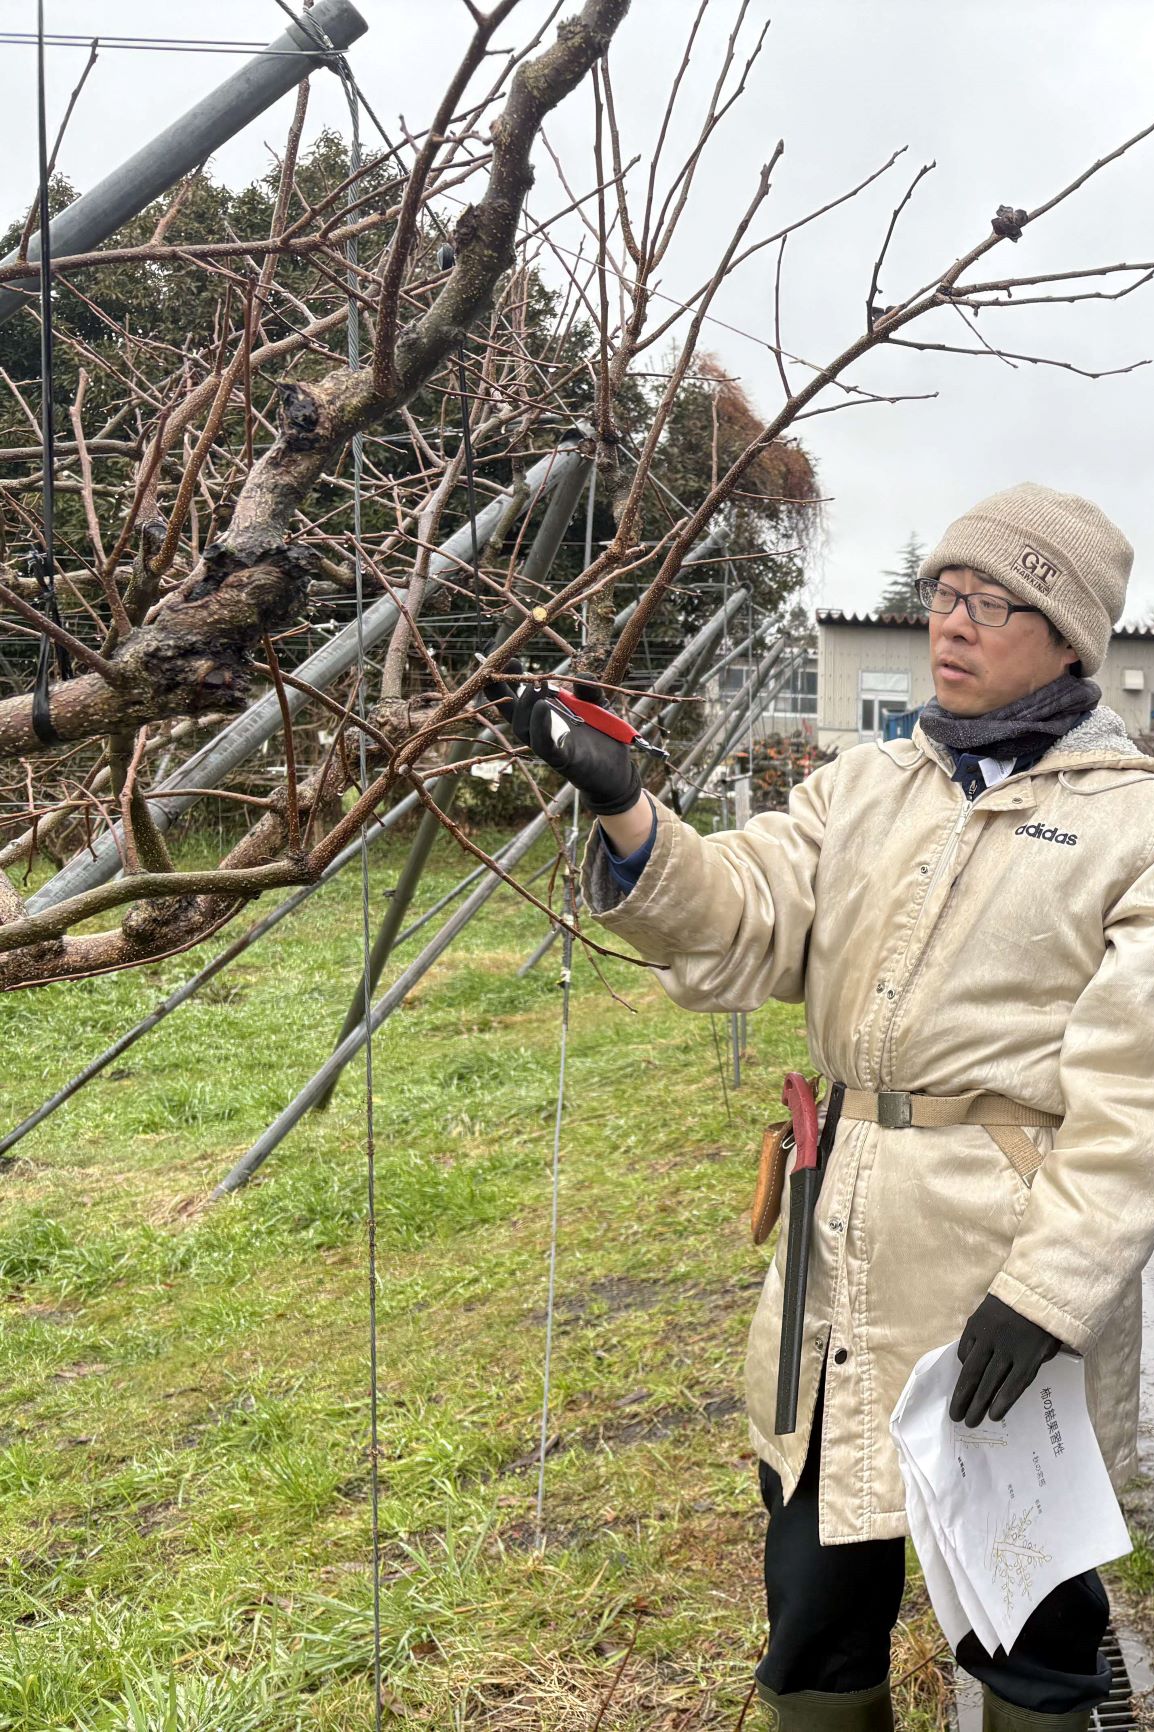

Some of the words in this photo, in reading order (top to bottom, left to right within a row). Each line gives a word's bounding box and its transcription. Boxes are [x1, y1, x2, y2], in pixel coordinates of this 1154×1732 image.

[1013, 565, 1049, 594] HAWKINS
[1021, 550, 1057, 584] GT
[1015, 823, 1078, 846] adidas
[1040, 1387, 1065, 1457] 柿の結果習性
